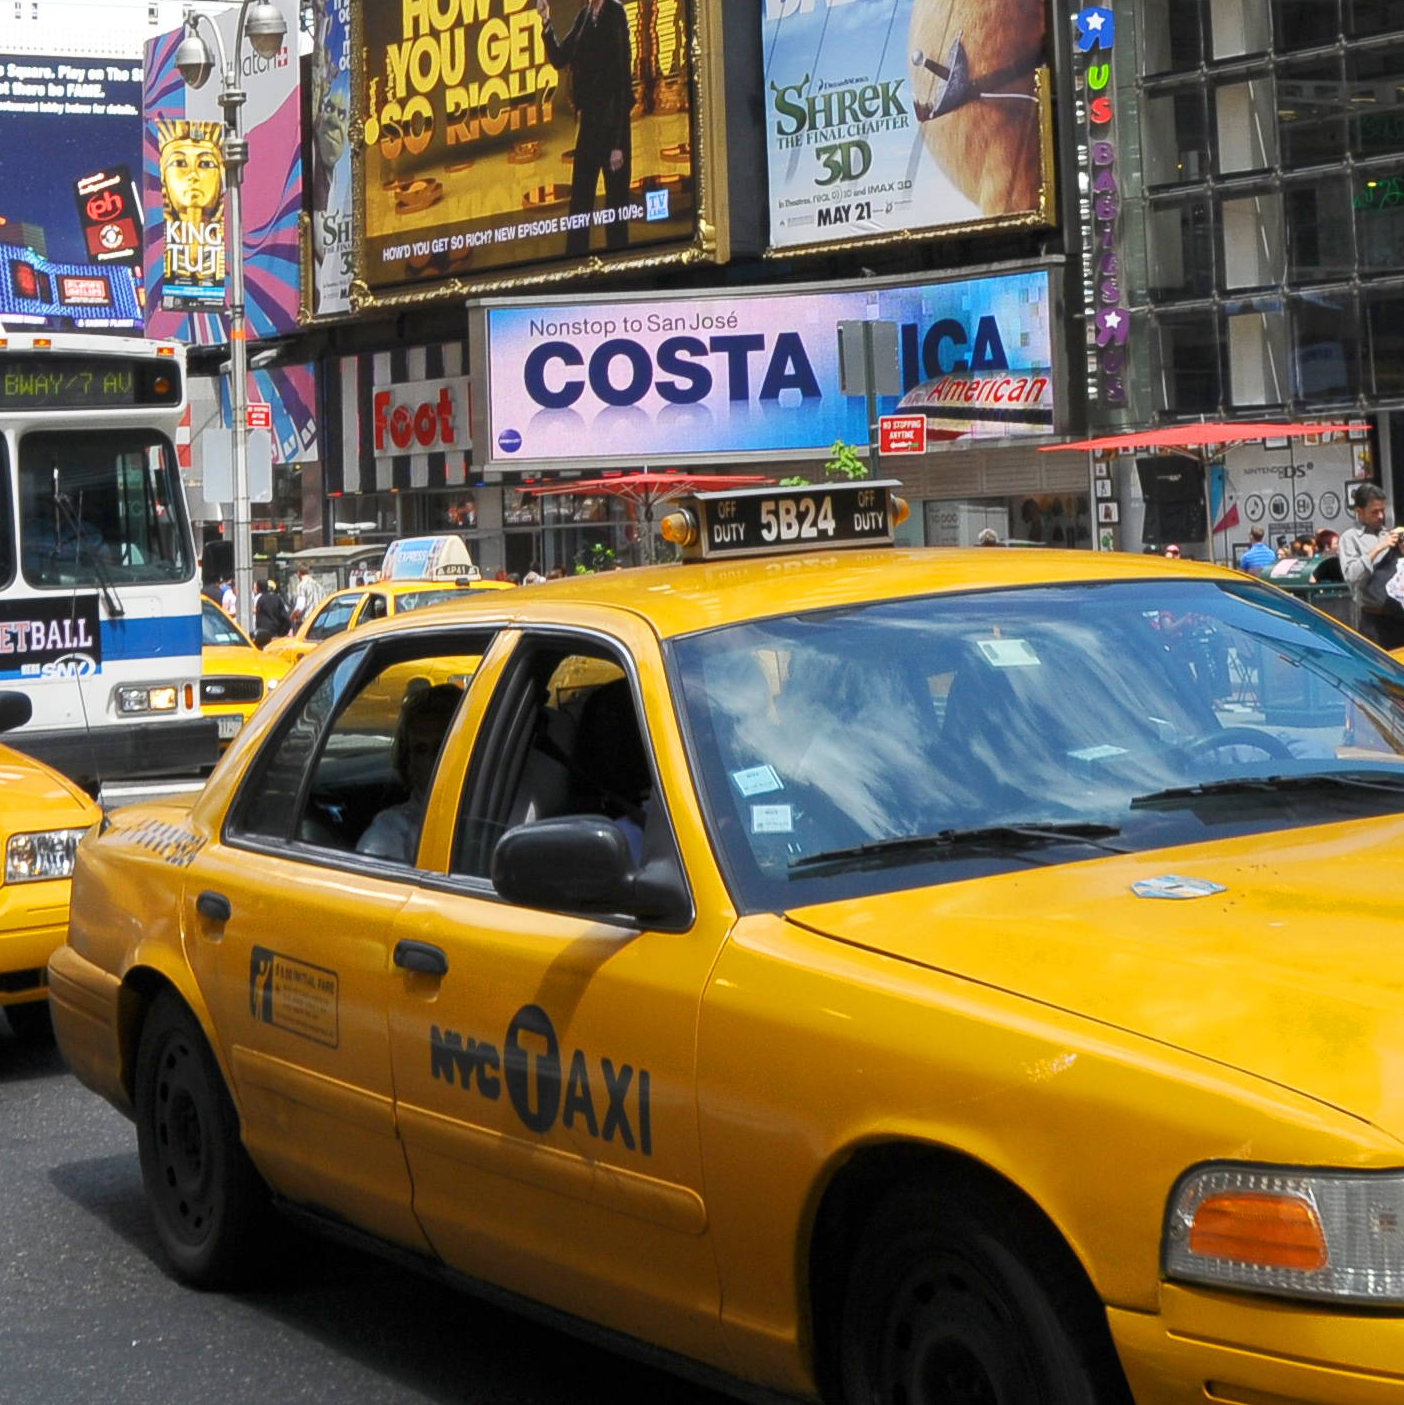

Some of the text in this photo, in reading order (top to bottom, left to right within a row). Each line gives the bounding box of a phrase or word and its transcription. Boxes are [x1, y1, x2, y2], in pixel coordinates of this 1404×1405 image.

[387, 30, 467, 102] YOU
[477, 7, 545, 78] GET
[106, 66, 129, 82] The
[380, 65, 560, 161] SO RICH?
[776, 115, 910, 150] THE FINAL CHAPTER
[814, 139, 873, 186] 3D
[817, 205, 851, 227] MAY
[854, 201, 872, 222] 21
[166, 221, 223, 245] KING
[412, 243, 430, 258] YOU
[431, 240, 449, 256] GET
[450, 237, 463, 252] SO
[465, 232, 493, 249] RICH?
[494, 227, 516, 243] NEW
[517, 218, 558, 239] EPISODE
[560, 212, 590, 232] EVERY
[592, 208, 616, 227] WED
[167, 244, 222, 272] TUT
[528, 310, 739, 338] Nonstop to San José
[523, 314, 1010, 410] COSTA ICA
[103, 371, 133, 394] AV
[927, 373, 1048, 404] American
[375, 387, 455, 450] Foot
[883, 419, 922, 429] NO STOPPING
[889, 430, 915, 439] ANYTIME
[714, 512, 884, 543] DUTY DUTY
[718, 490, 875, 542] OFF 5B24 OFF
[41, 660, 92, 679] SNY
[430, 1016, 653, 1156] NYC TAXI
